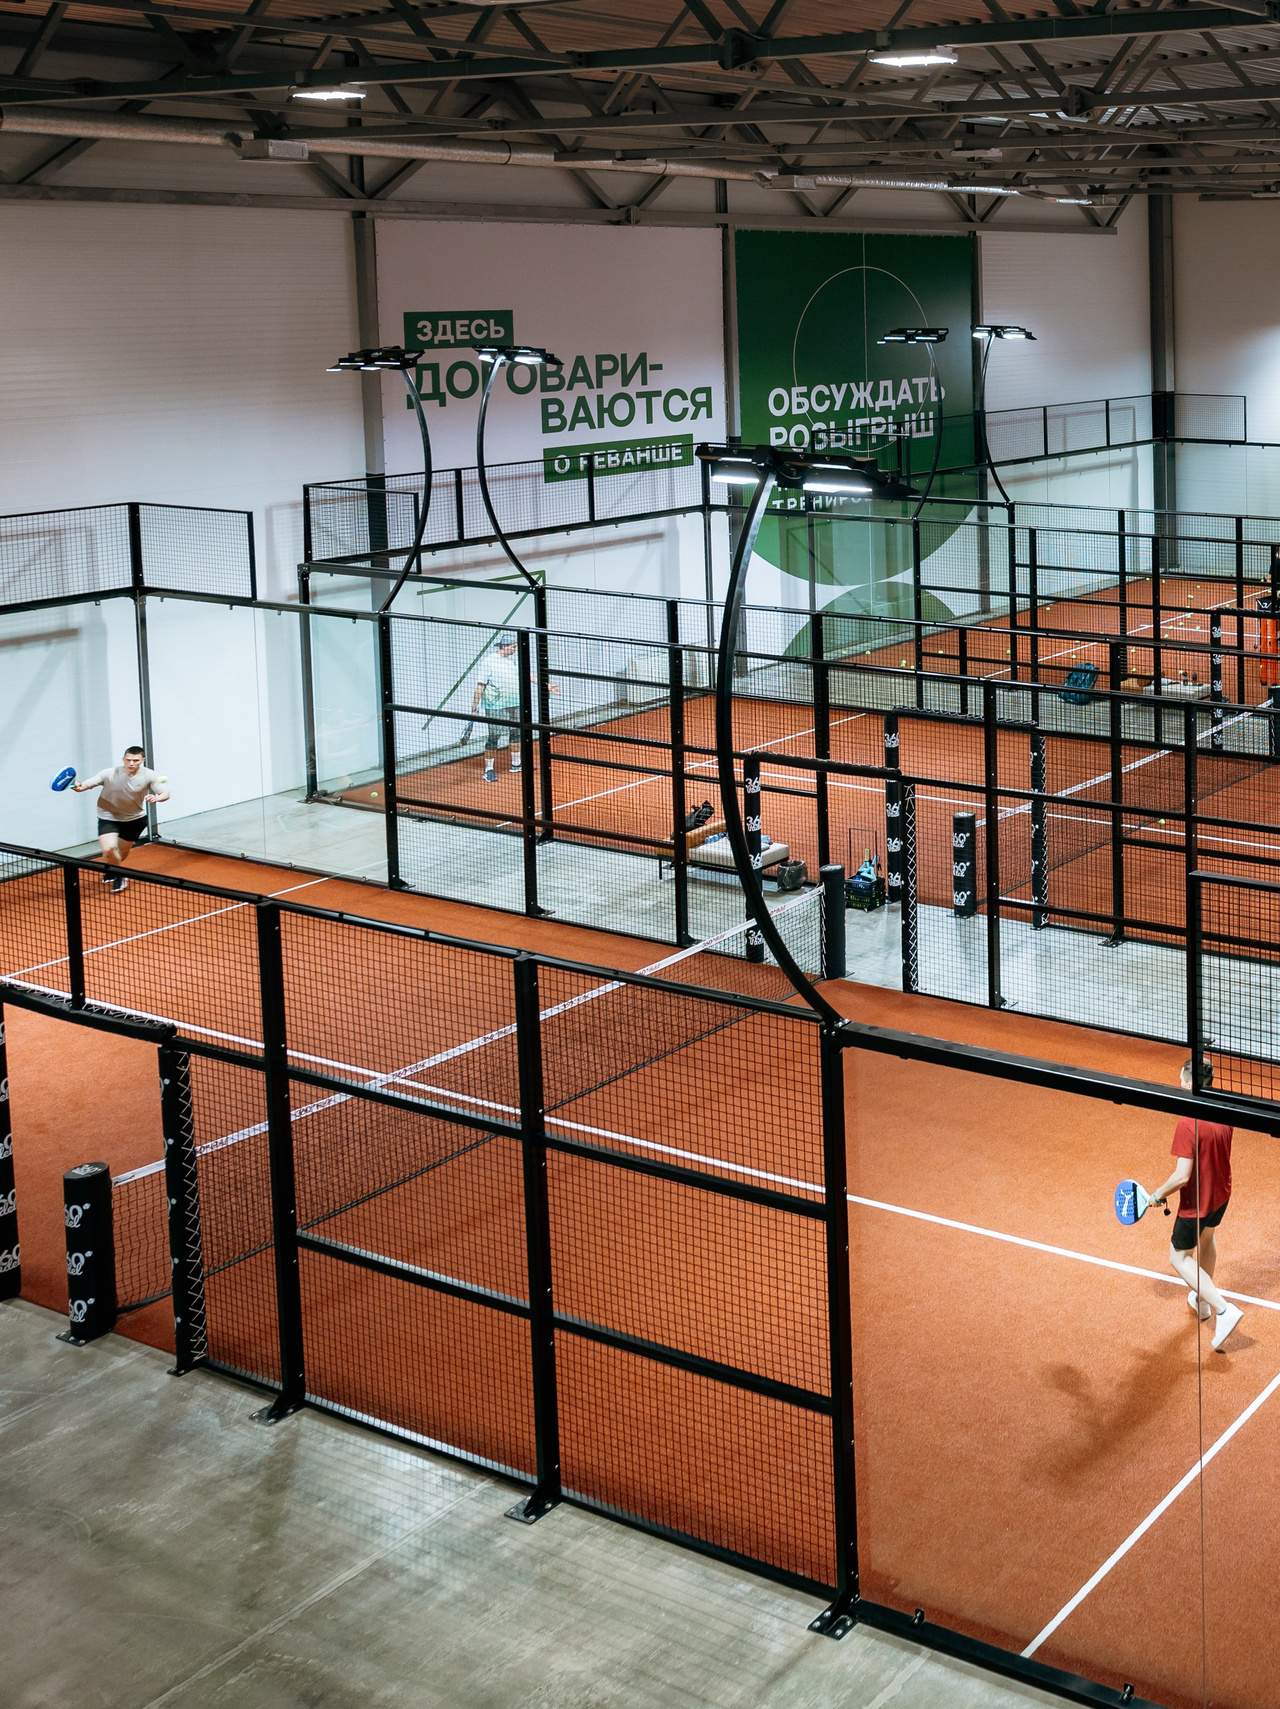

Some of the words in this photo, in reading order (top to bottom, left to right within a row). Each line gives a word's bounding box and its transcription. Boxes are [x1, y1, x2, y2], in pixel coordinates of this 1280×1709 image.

[416, 319, 505, 344] ЗДЕСЬ
[540, 386, 713, 434] ВАЮТСЯ
[768, 376, 946, 417] ОБСУЖДАТЬ
[554, 454, 571, 474] О
